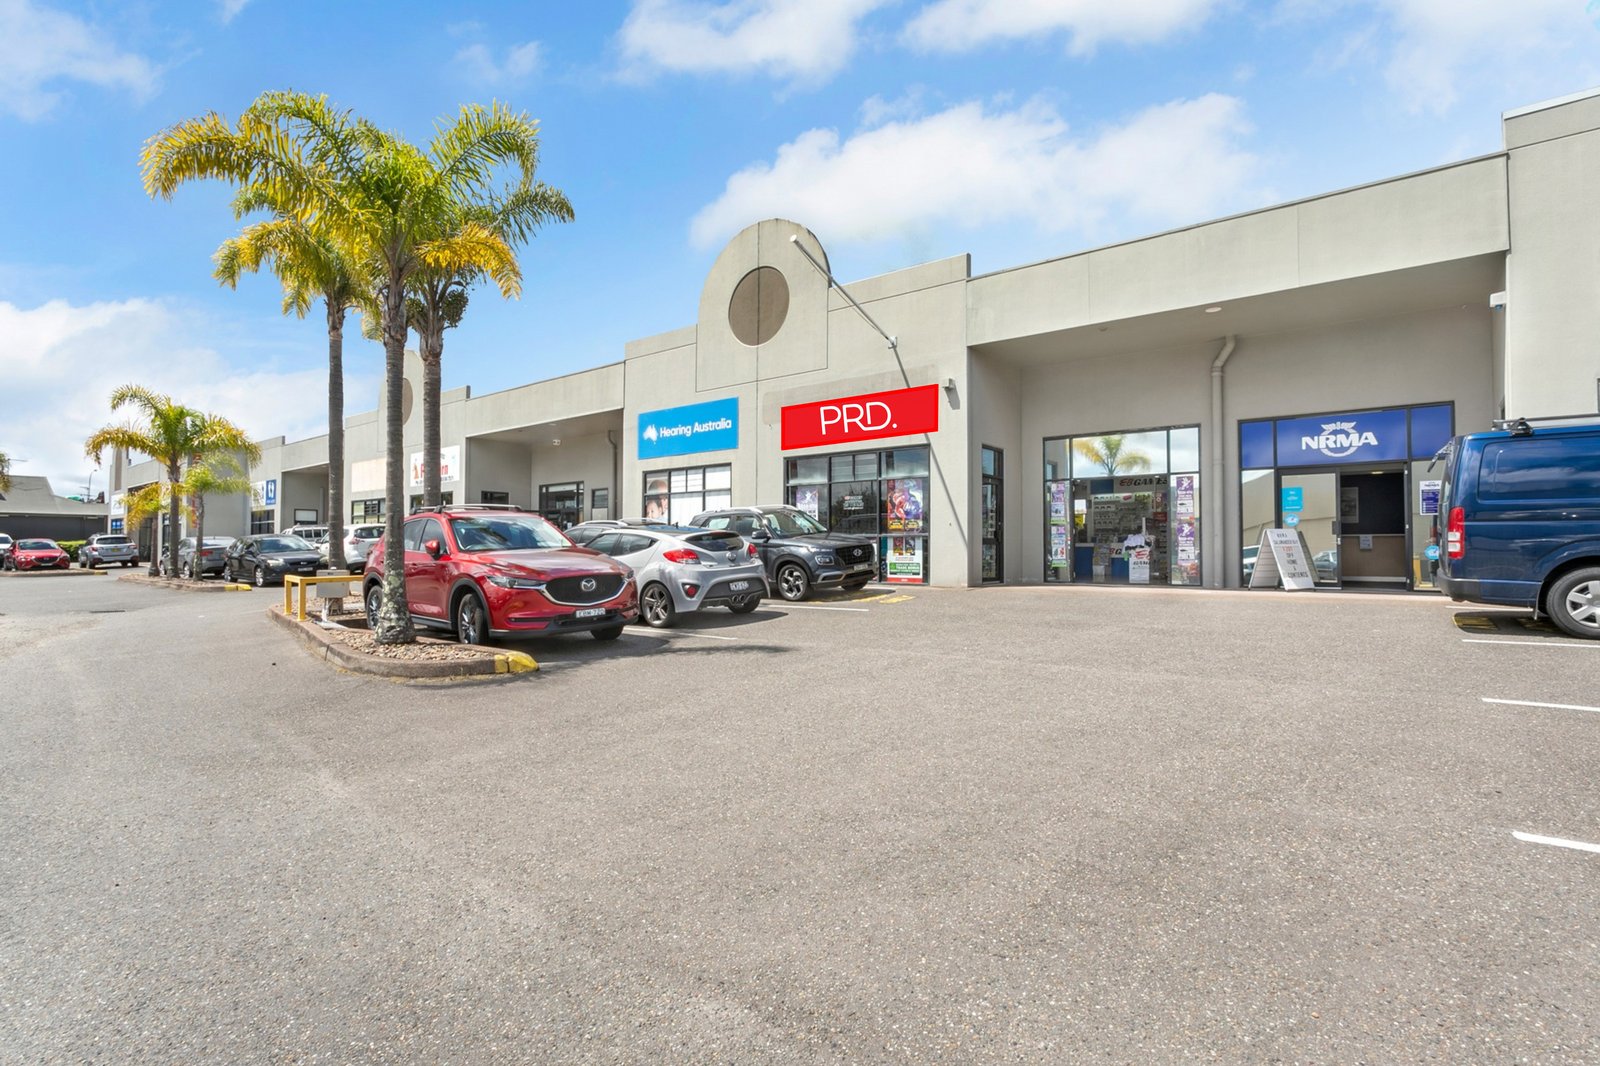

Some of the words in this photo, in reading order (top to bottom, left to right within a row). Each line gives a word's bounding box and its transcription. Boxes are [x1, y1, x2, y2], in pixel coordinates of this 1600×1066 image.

[660, 424, 692, 438] Hearing
[693, 417, 732, 433] Australia
[820, 401, 898, 435] PRD.
[1302, 432, 1378, 450] NRMA
